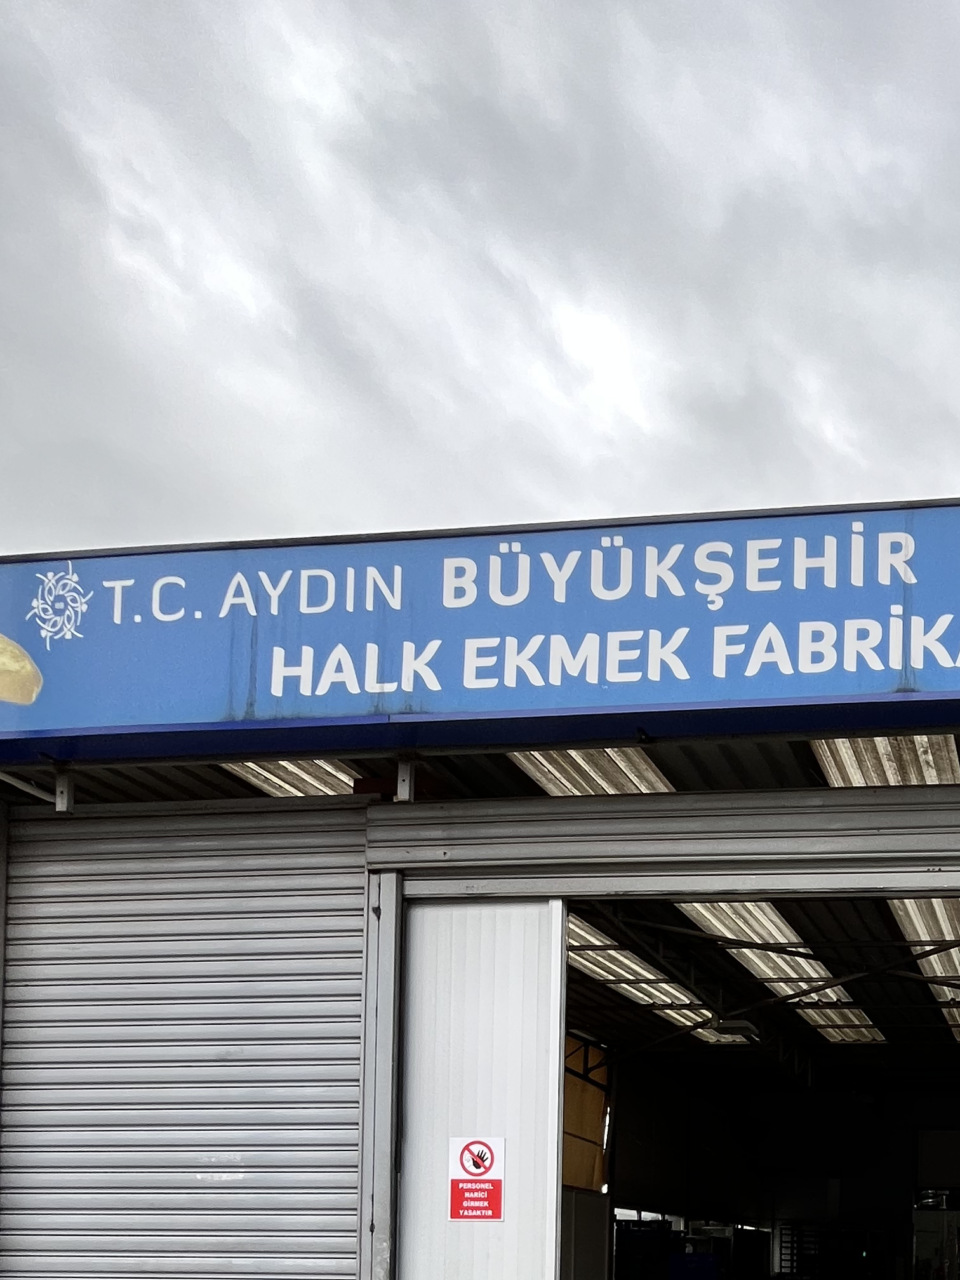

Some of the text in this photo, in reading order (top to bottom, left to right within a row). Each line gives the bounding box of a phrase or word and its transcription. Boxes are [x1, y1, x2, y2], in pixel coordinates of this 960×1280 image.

[103, 576, 202, 625] T.C.
[218, 565, 402, 618] AYDIN
[443, 521, 918, 611] BÜYÜKŞEHİR
[271, 639, 443, 697] HALK
[463, 627, 691, 689] EKMEK
[462, 1199, 489, 1207] GİRMEK
